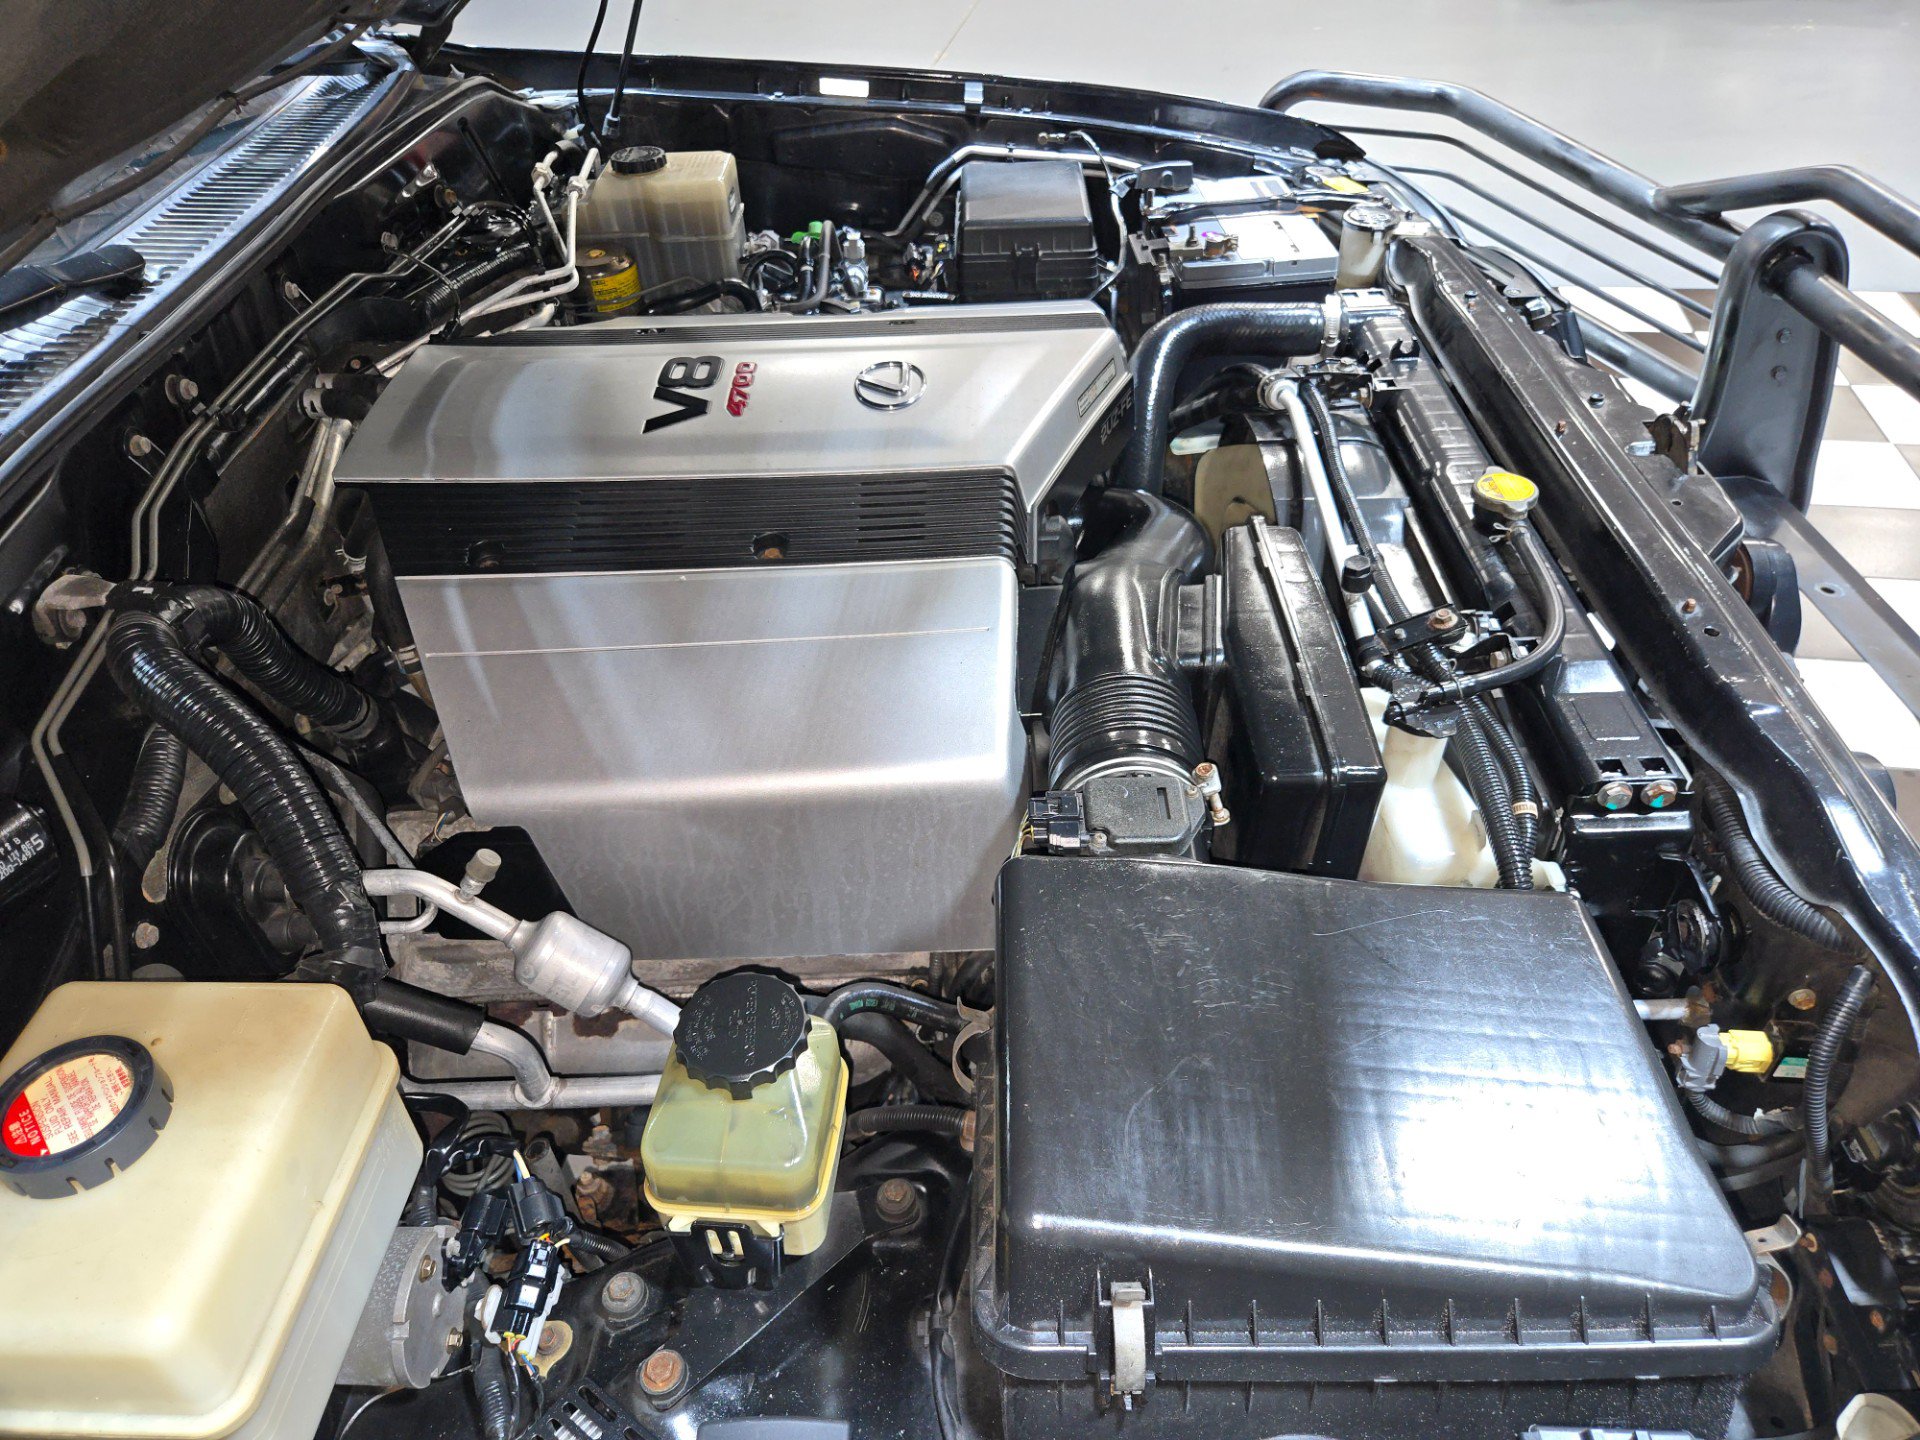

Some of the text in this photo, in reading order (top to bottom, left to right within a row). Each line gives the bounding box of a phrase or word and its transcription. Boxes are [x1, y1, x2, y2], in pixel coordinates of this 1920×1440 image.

[641, 355, 724, 434] V8
[726, 362, 757, 417] 4700
[19, 1109, 41, 1145] NOTICE
[31, 1101, 52, 1140] SUSPENSION
[49, 1116, 62, 1135] FLUID
[57, 1106, 72, 1129] REPAIR
[67, 1130, 79, 1144] SEE
